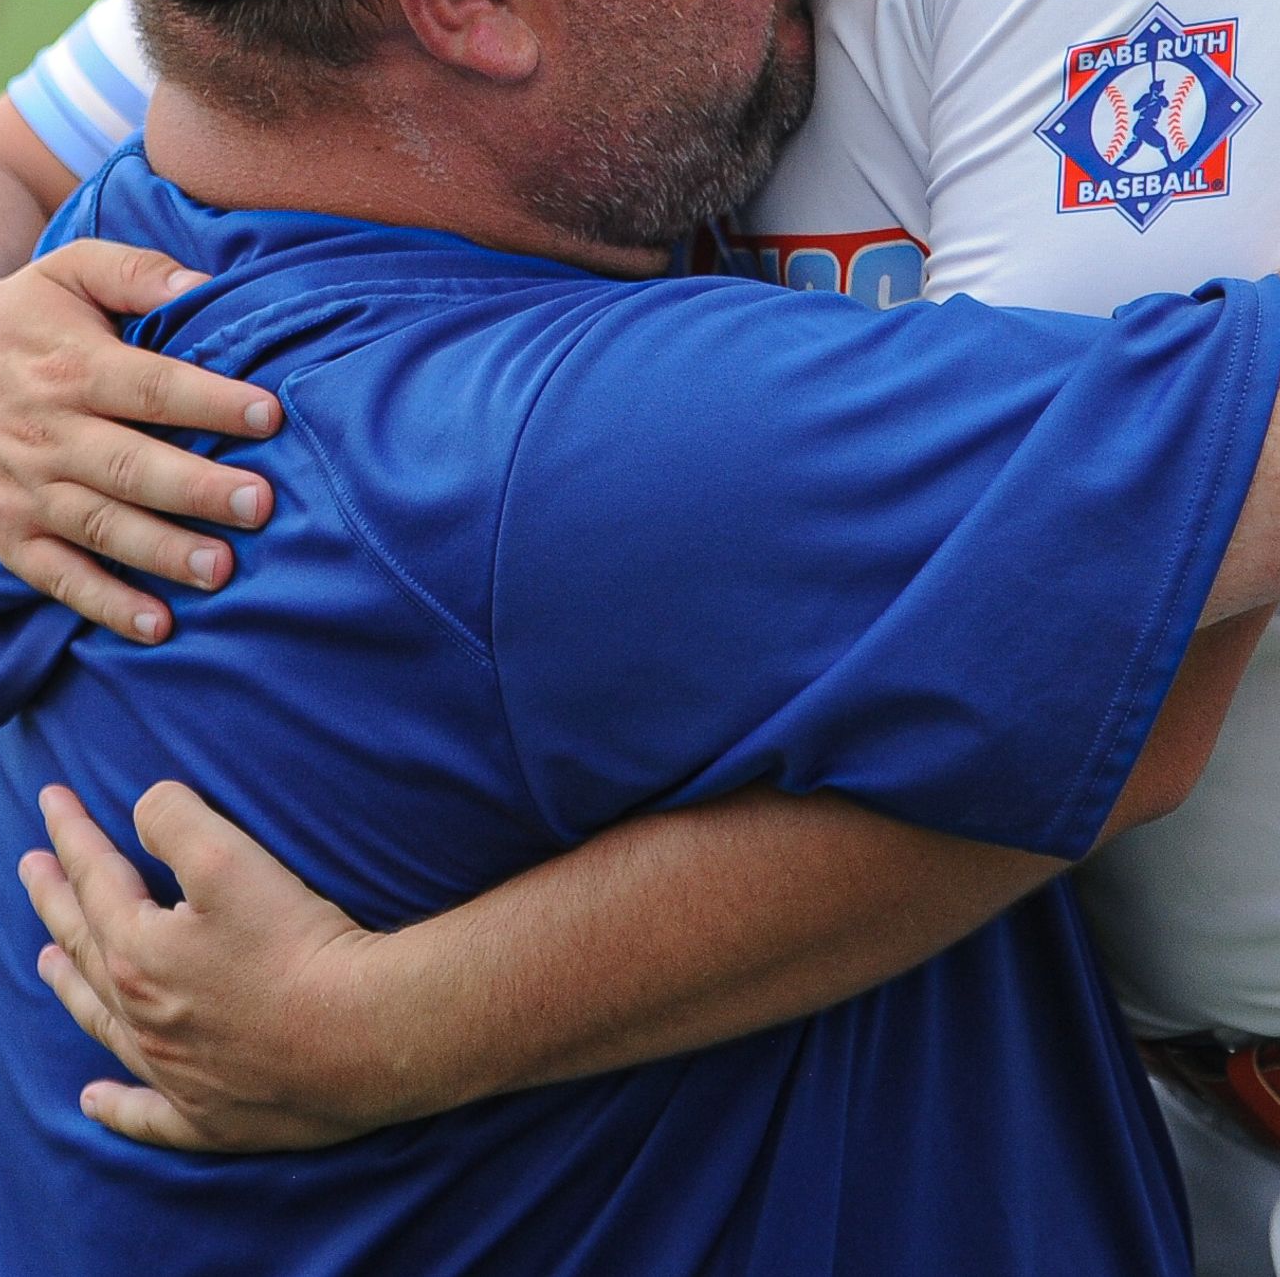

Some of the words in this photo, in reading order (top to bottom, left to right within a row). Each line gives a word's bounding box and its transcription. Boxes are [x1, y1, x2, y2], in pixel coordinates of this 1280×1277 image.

[1078, 42, 1147, 71] BABE
[1156, 30, 1227, 61] RUTH
[1078, 170, 1208, 203] BASEBALL
